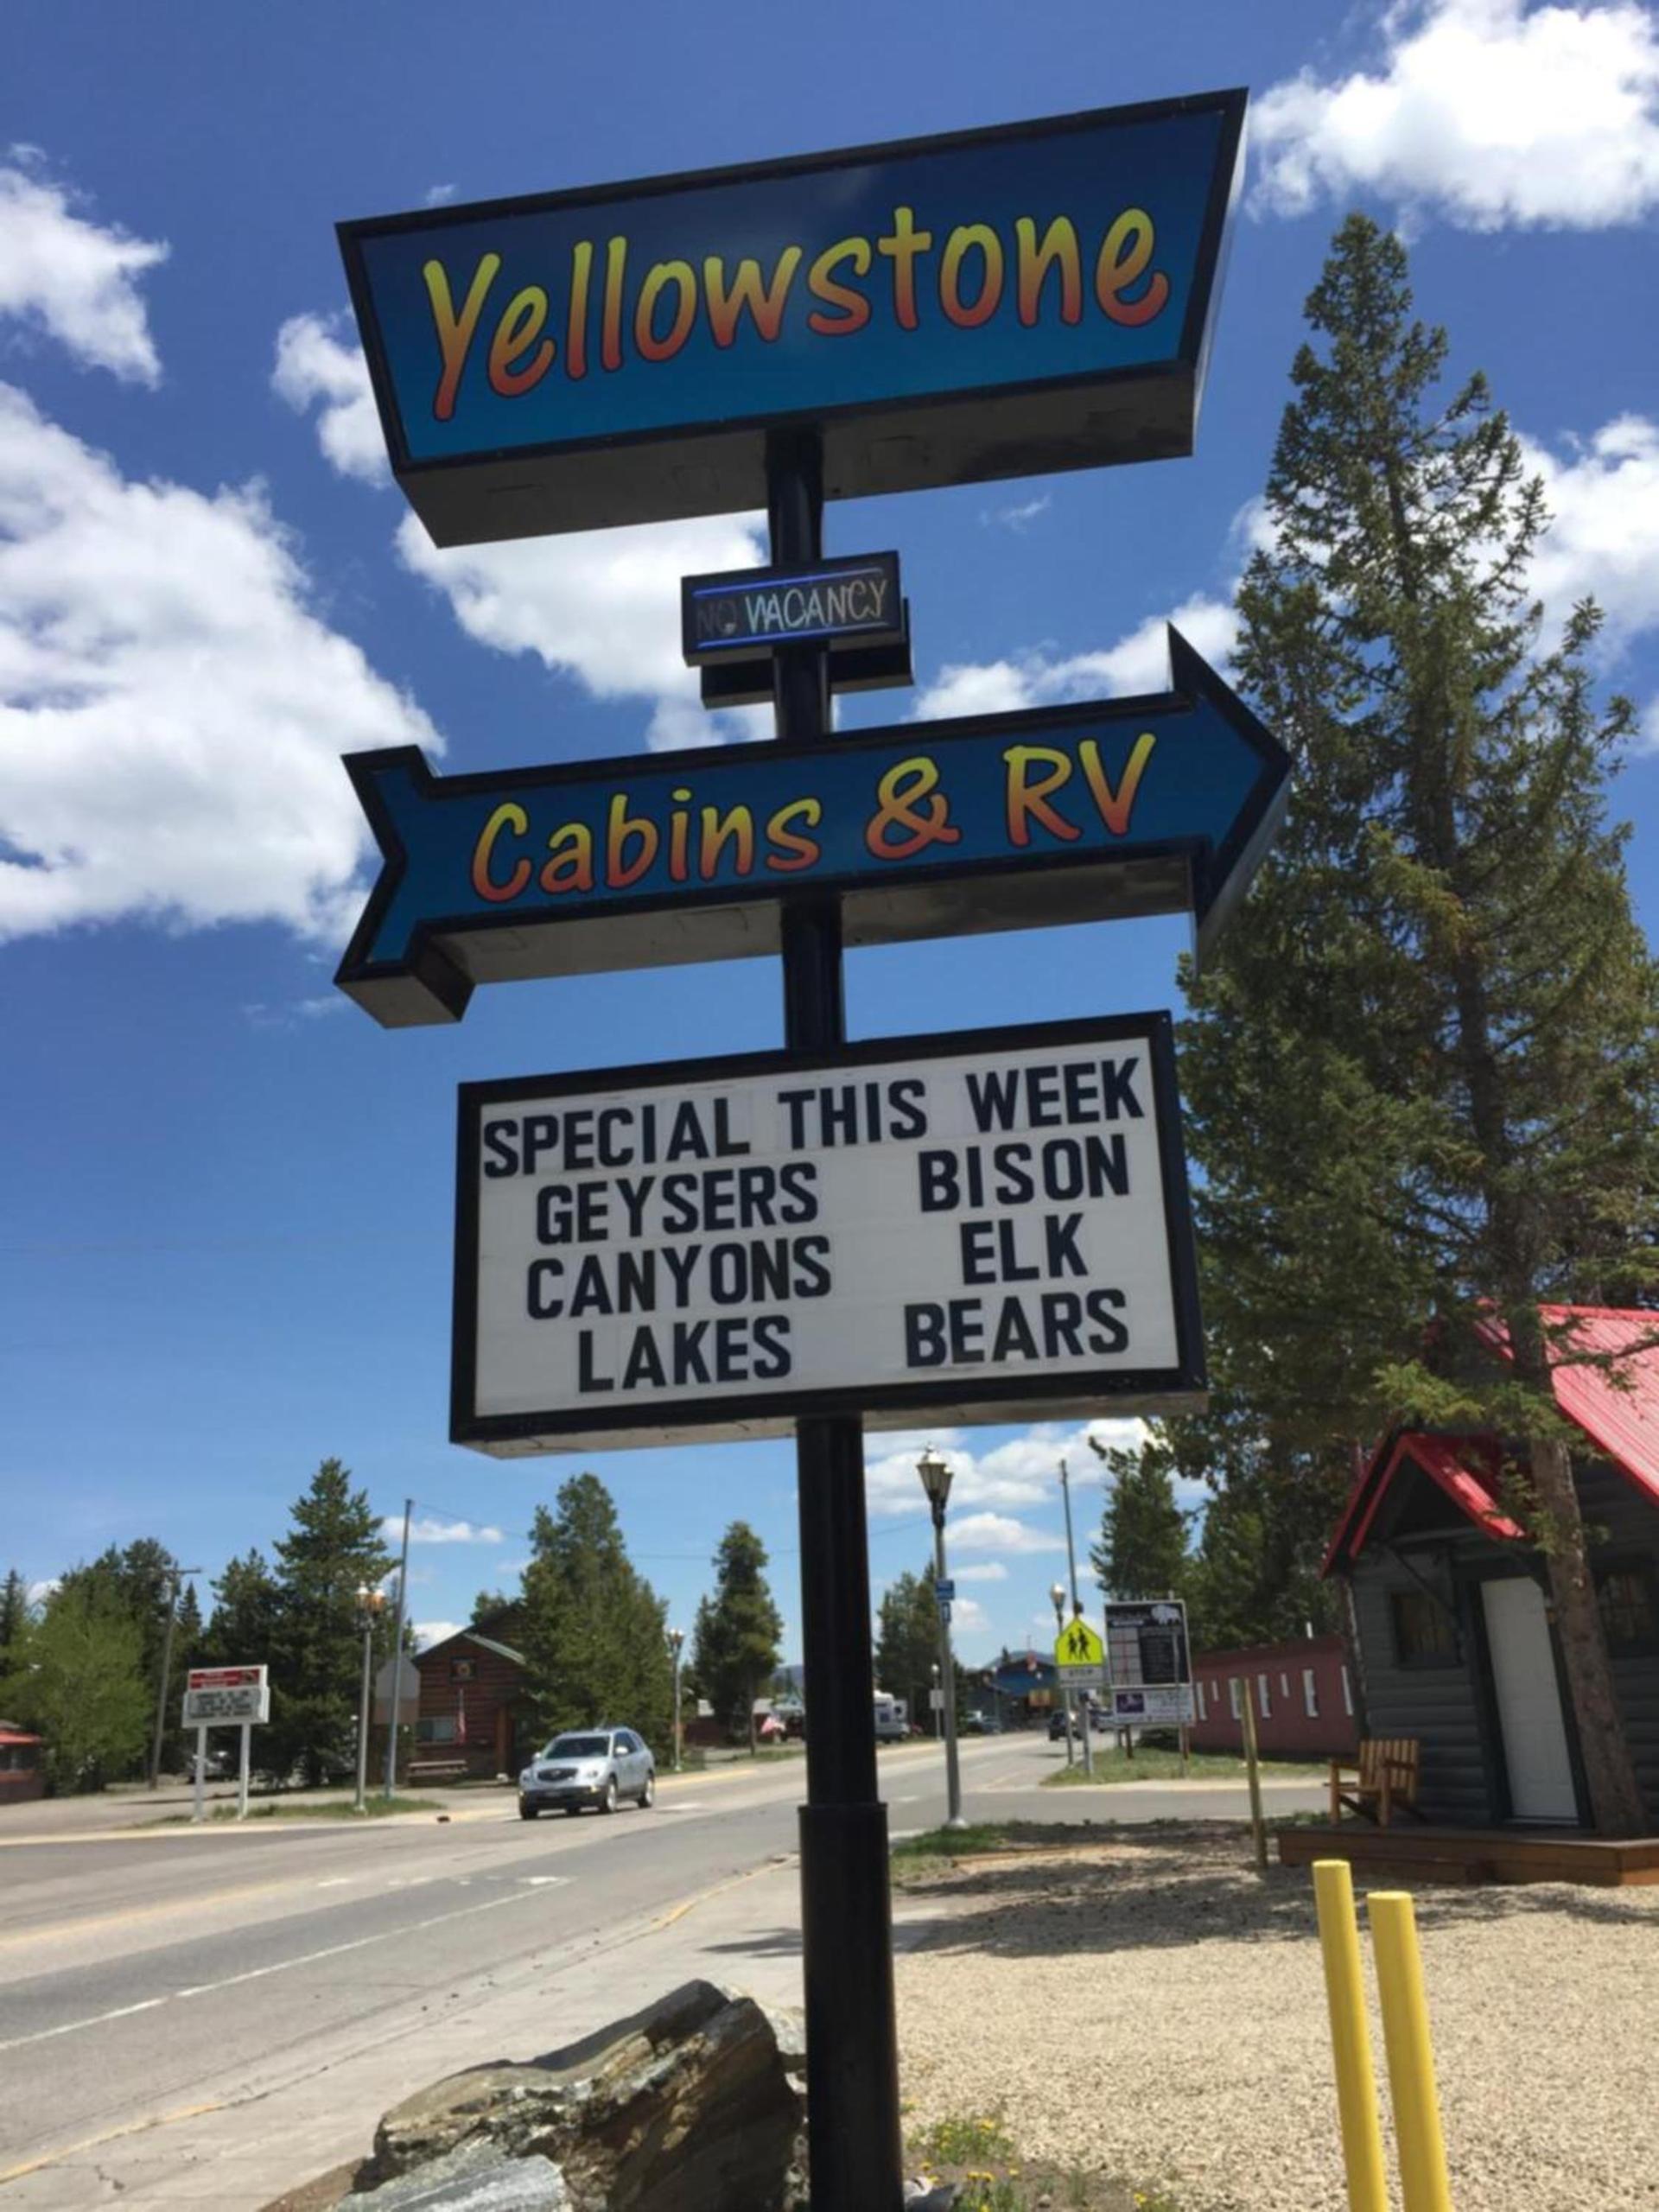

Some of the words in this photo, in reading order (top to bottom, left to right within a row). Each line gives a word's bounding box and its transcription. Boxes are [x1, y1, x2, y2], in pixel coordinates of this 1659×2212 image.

[423, 206, 1170, 423] Yellowstone
[744, 579, 887, 634] VACANCY
[470, 787, 823, 902] Cabins
[866, 755, 961, 860] &
[1002, 732, 1158, 849] RV
[483, 1098, 750, 1179] SPECIAL
[778, 1078, 927, 1150] THIS
[965, 1058, 1144, 1133] WEEK
[536, 1161, 819, 1245] GEYSERS
[918, 1133, 1129, 1213] BISON
[527, 1234, 831, 1320] CANYONS
[961, 1213, 1089, 1286] ELK
[578, 1314, 792, 1393] LAKES
[904, 1287, 1128, 1368] BEARS
